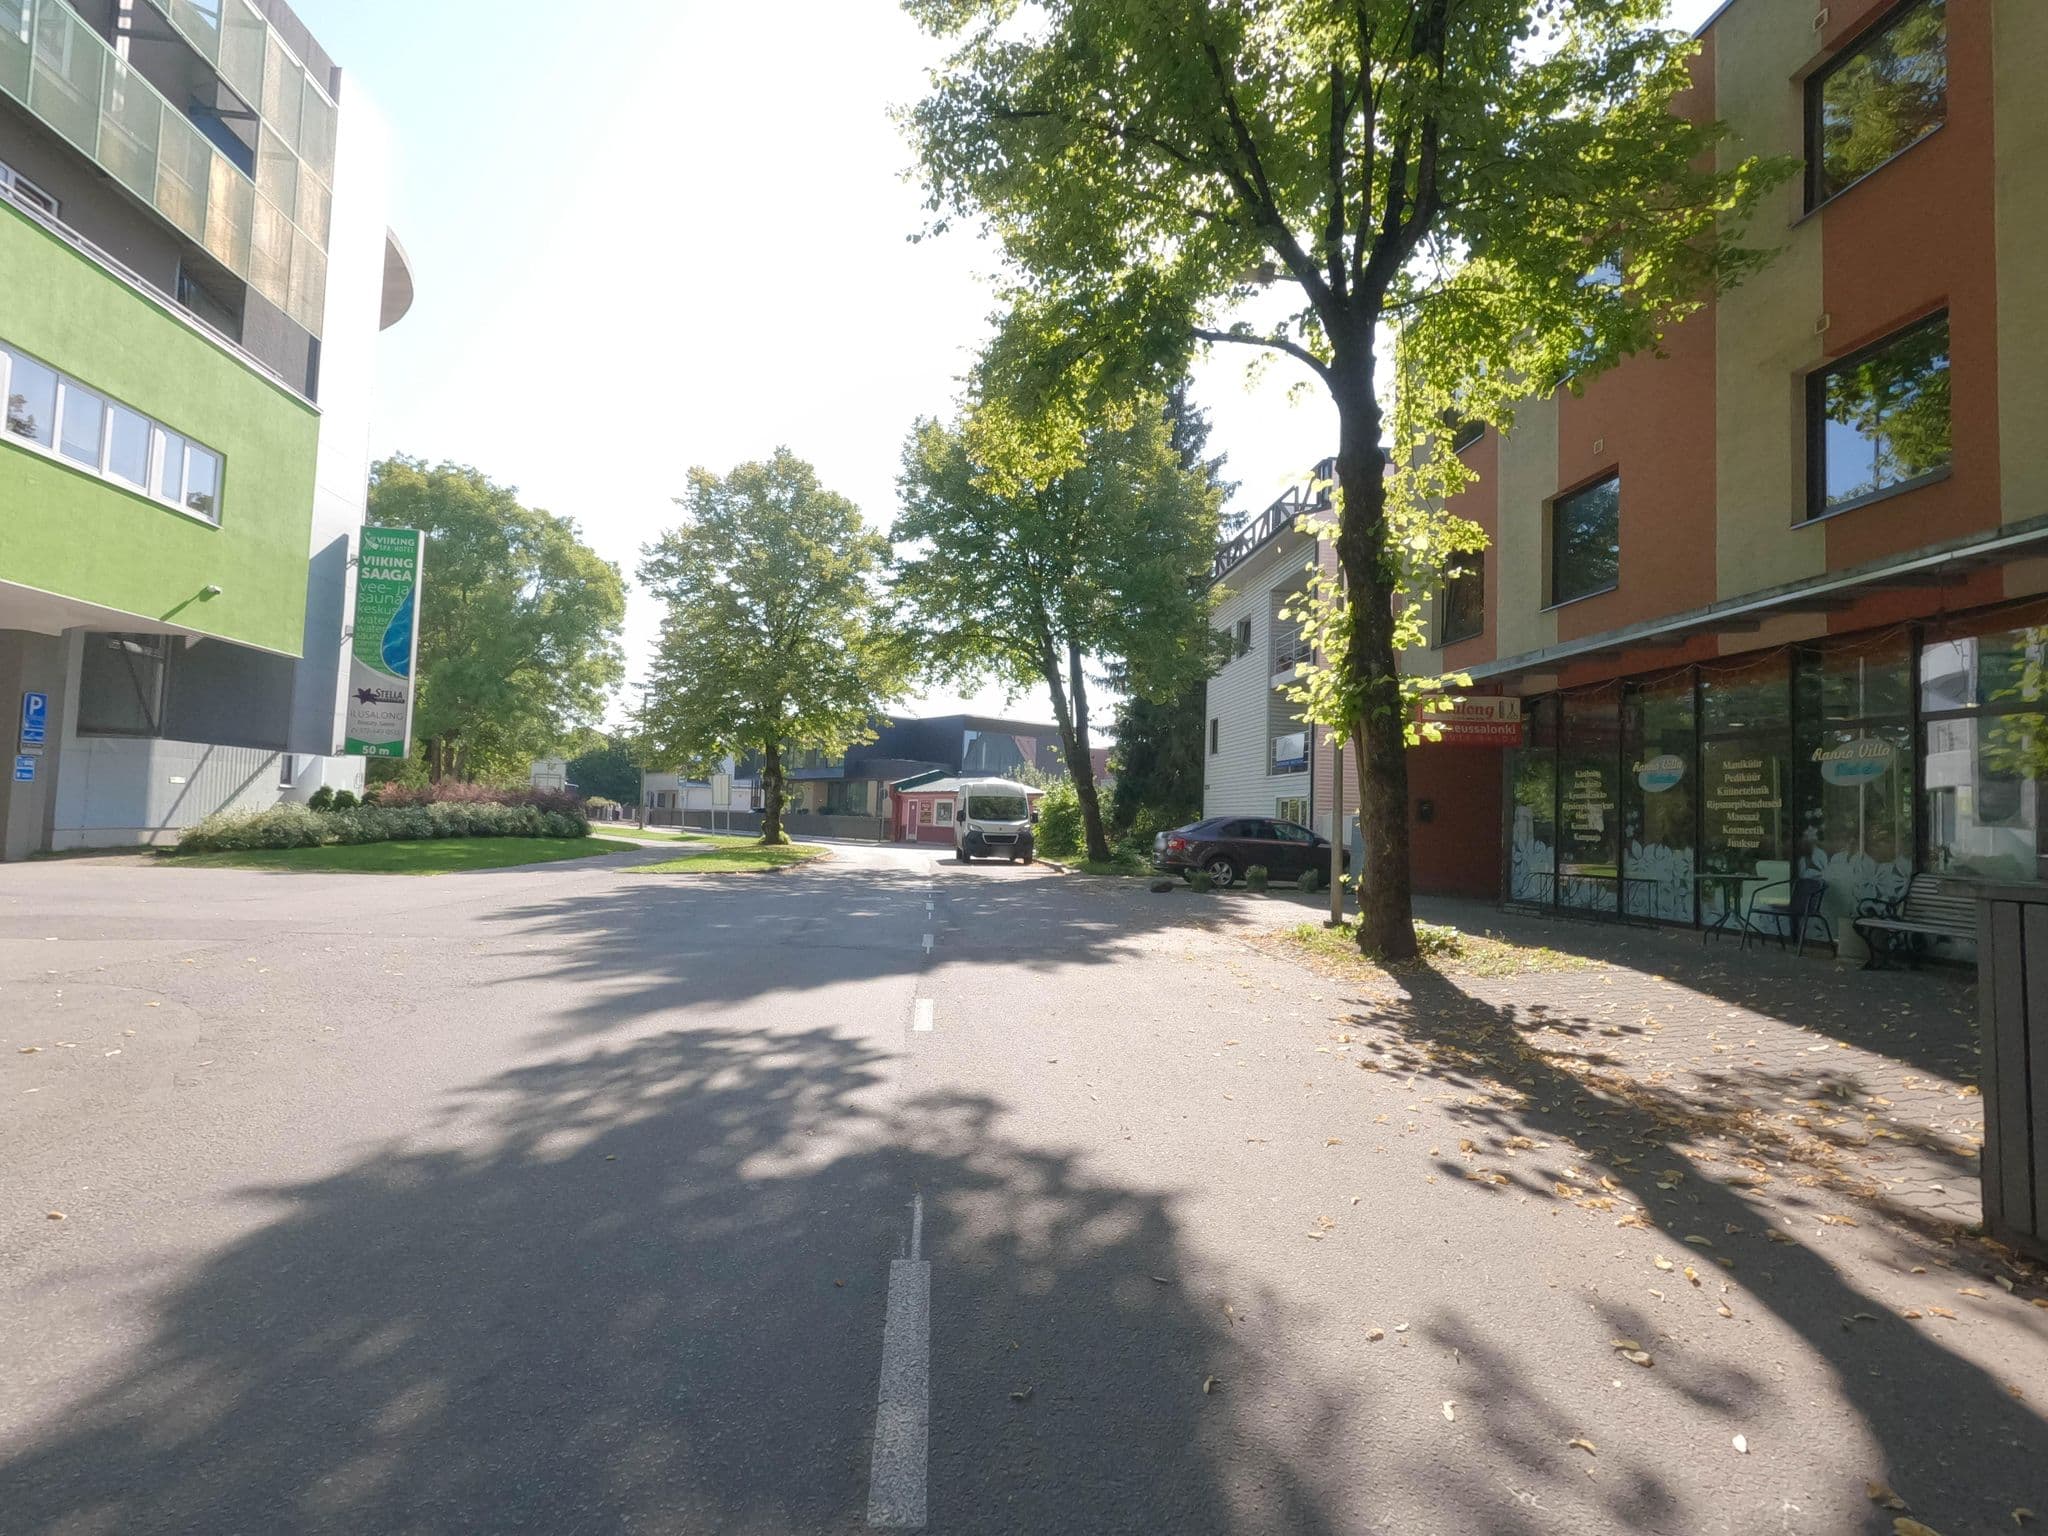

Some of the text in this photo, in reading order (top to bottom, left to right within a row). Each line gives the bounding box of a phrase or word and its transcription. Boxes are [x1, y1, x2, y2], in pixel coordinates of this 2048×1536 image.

[377, 536, 415, 547] VIIKING
[363, 555, 414, 569] VIIKING
[361, 568, 412, 581] SAAGA
[360, 583, 409, 596] vee- ja
[359, 592, 402, 605] sauna
[29, 695, 43, 715] P
[362, 745, 377, 755] 50
[1859, 743, 1890, 758] Villa
